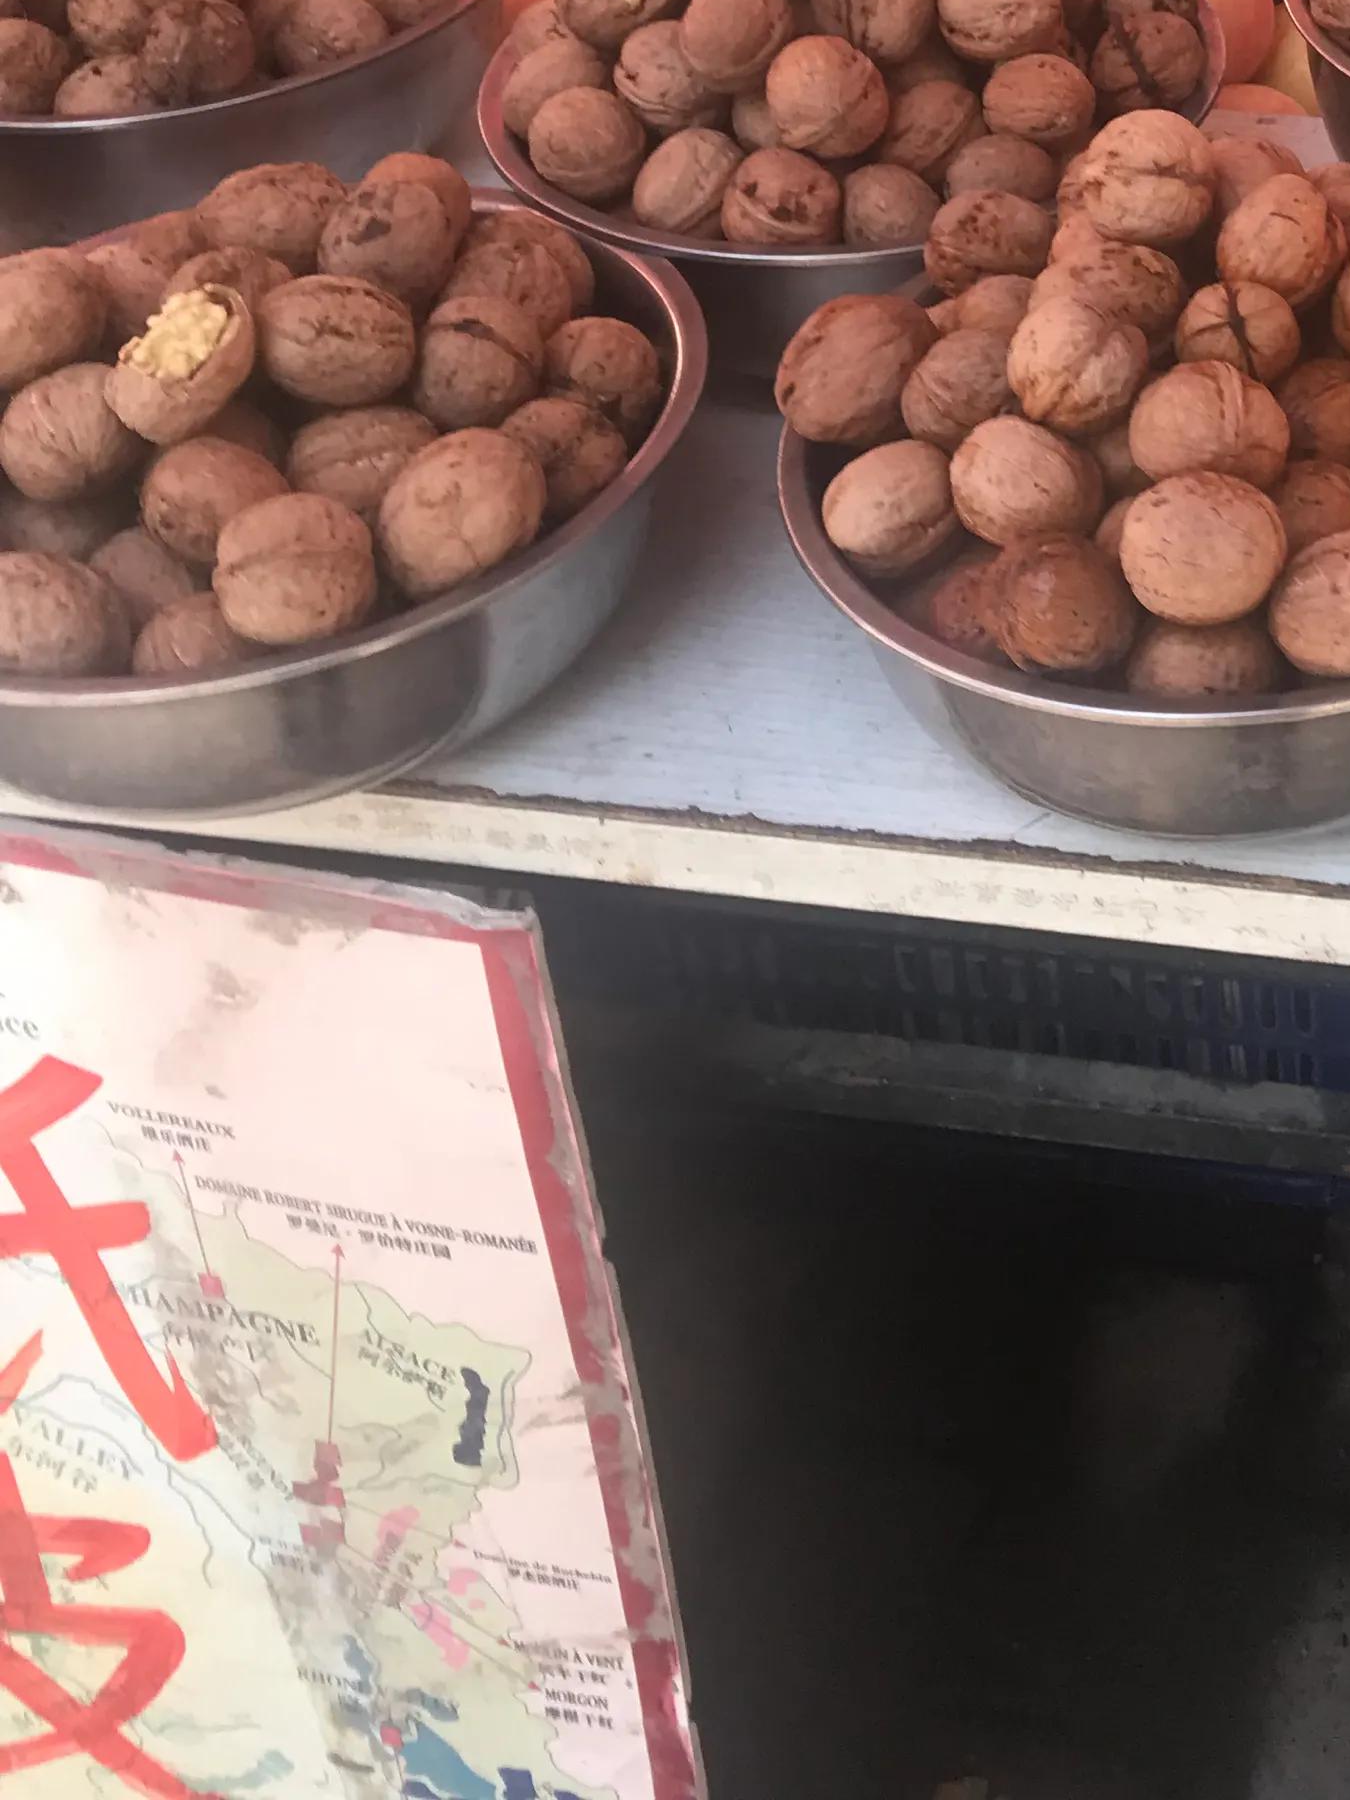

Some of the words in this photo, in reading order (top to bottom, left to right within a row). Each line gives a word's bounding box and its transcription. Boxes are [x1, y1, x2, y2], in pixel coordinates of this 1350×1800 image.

[106, 1100, 236, 1140] VOLLEREAUX
[194, 1174, 263, 1203] DOMAINE
[263, 1189, 321, 1215] ROBERT
[108, 1278, 321, 1348] HAMPAGNE
[544, 1686, 609, 1712] MORGON
